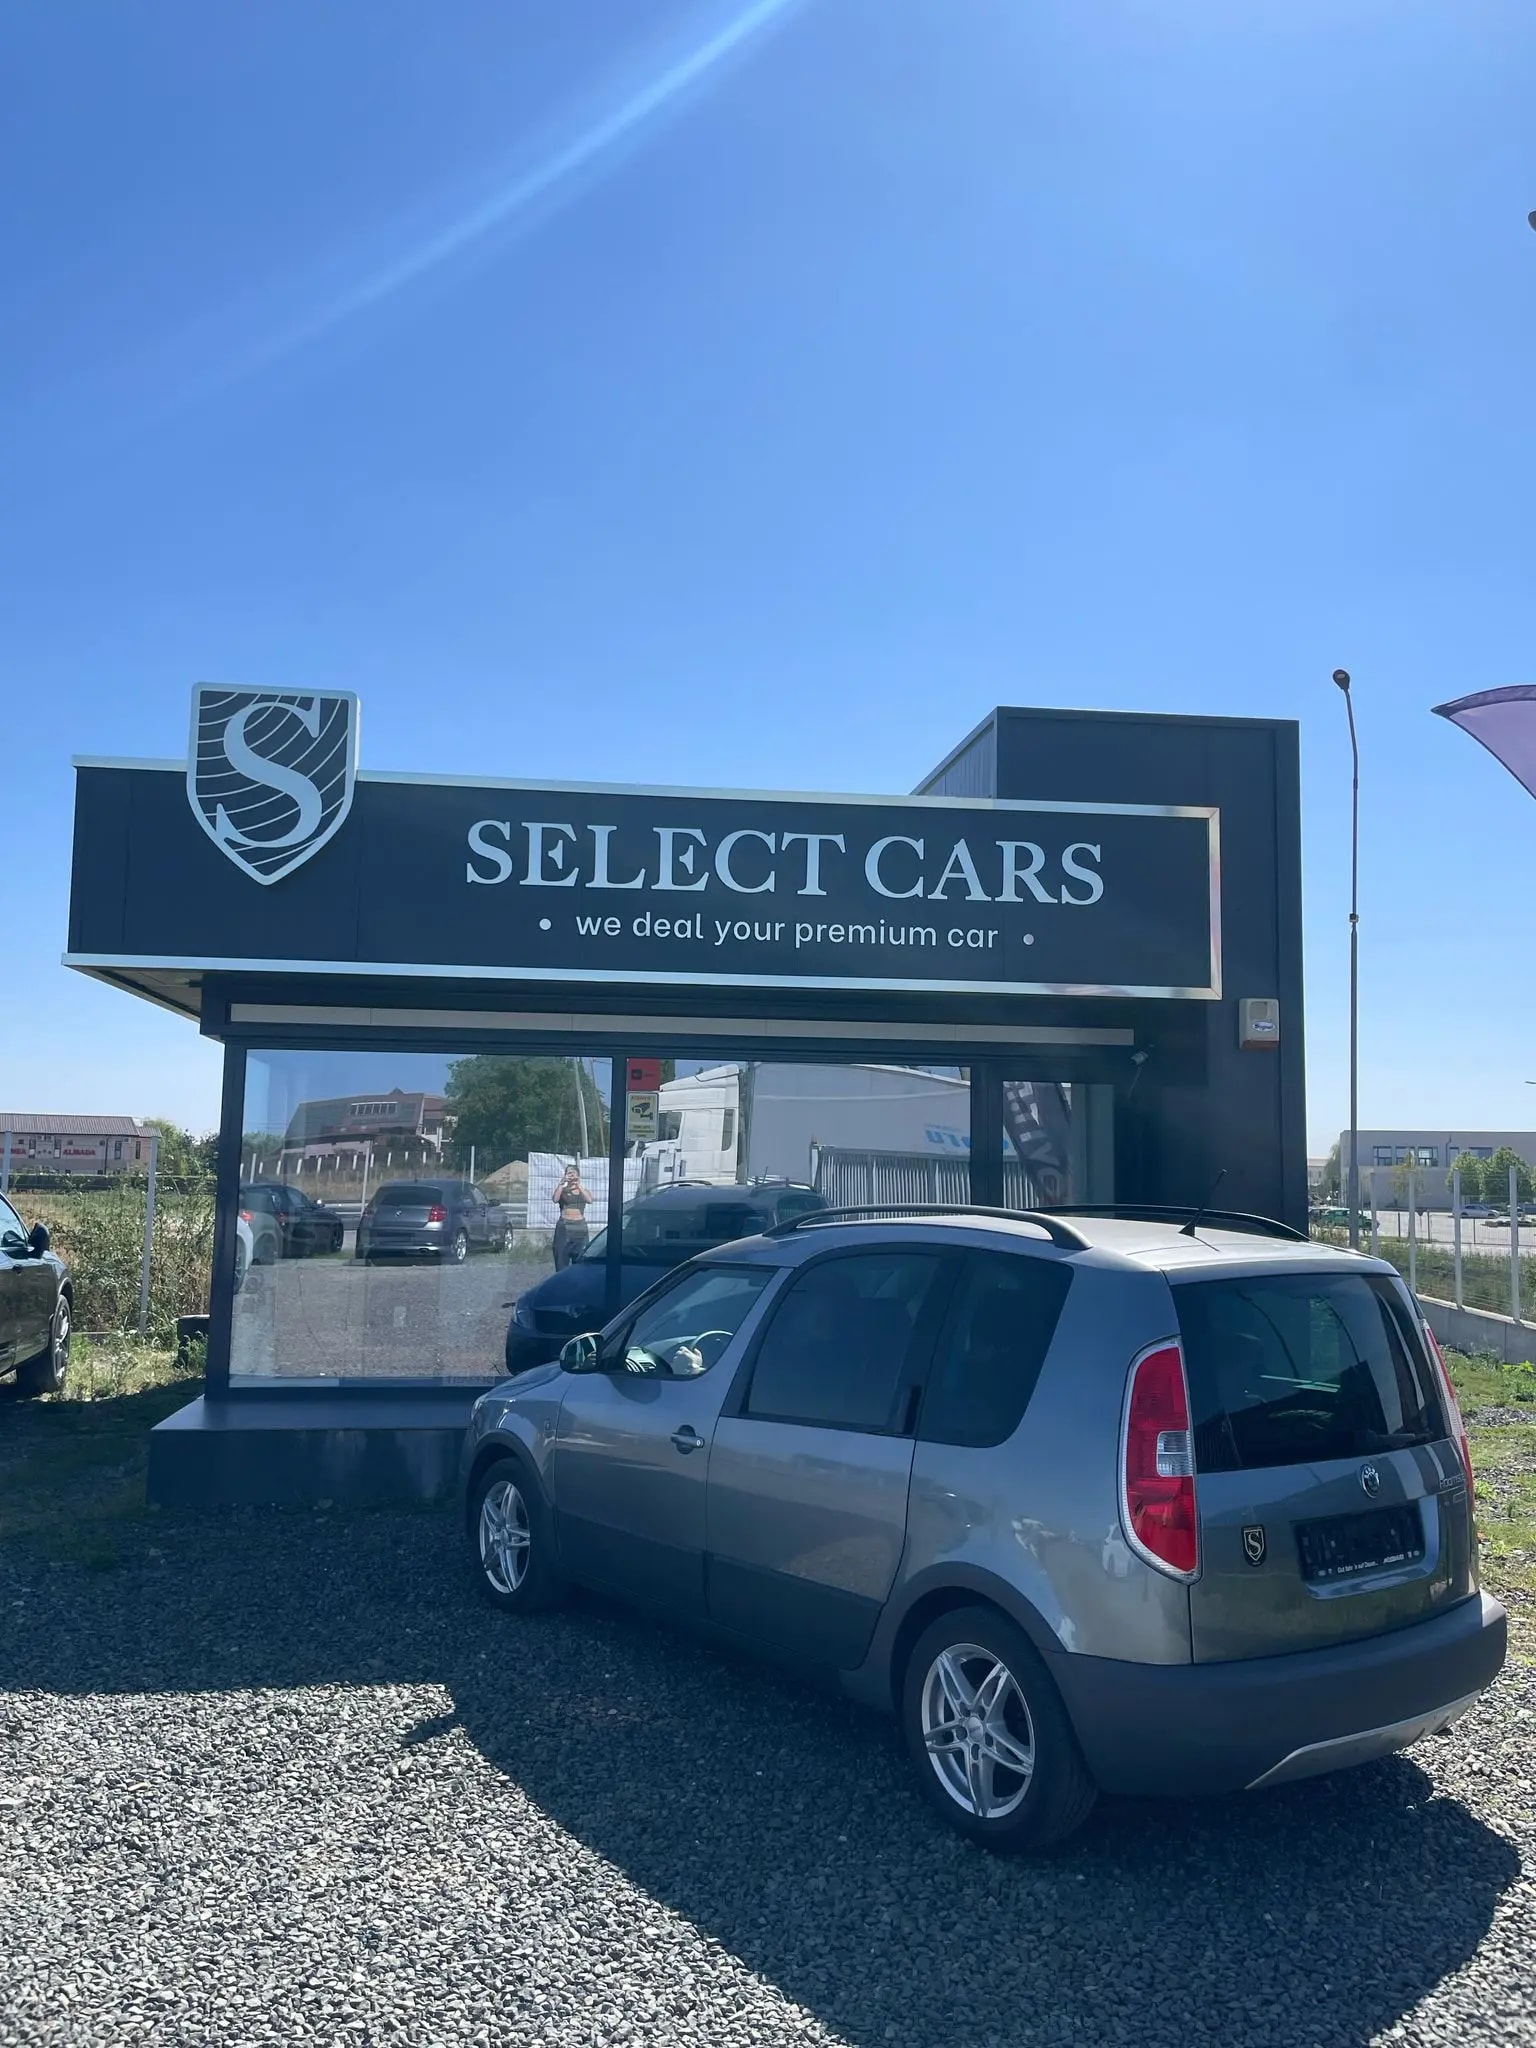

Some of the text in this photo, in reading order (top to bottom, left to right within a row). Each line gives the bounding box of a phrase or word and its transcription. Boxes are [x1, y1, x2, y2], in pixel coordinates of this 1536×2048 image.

[215, 698, 323, 849] S
[466, 819, 1105, 906] SELECT CARS
[575, 911, 999, 949] we deal your premium car
